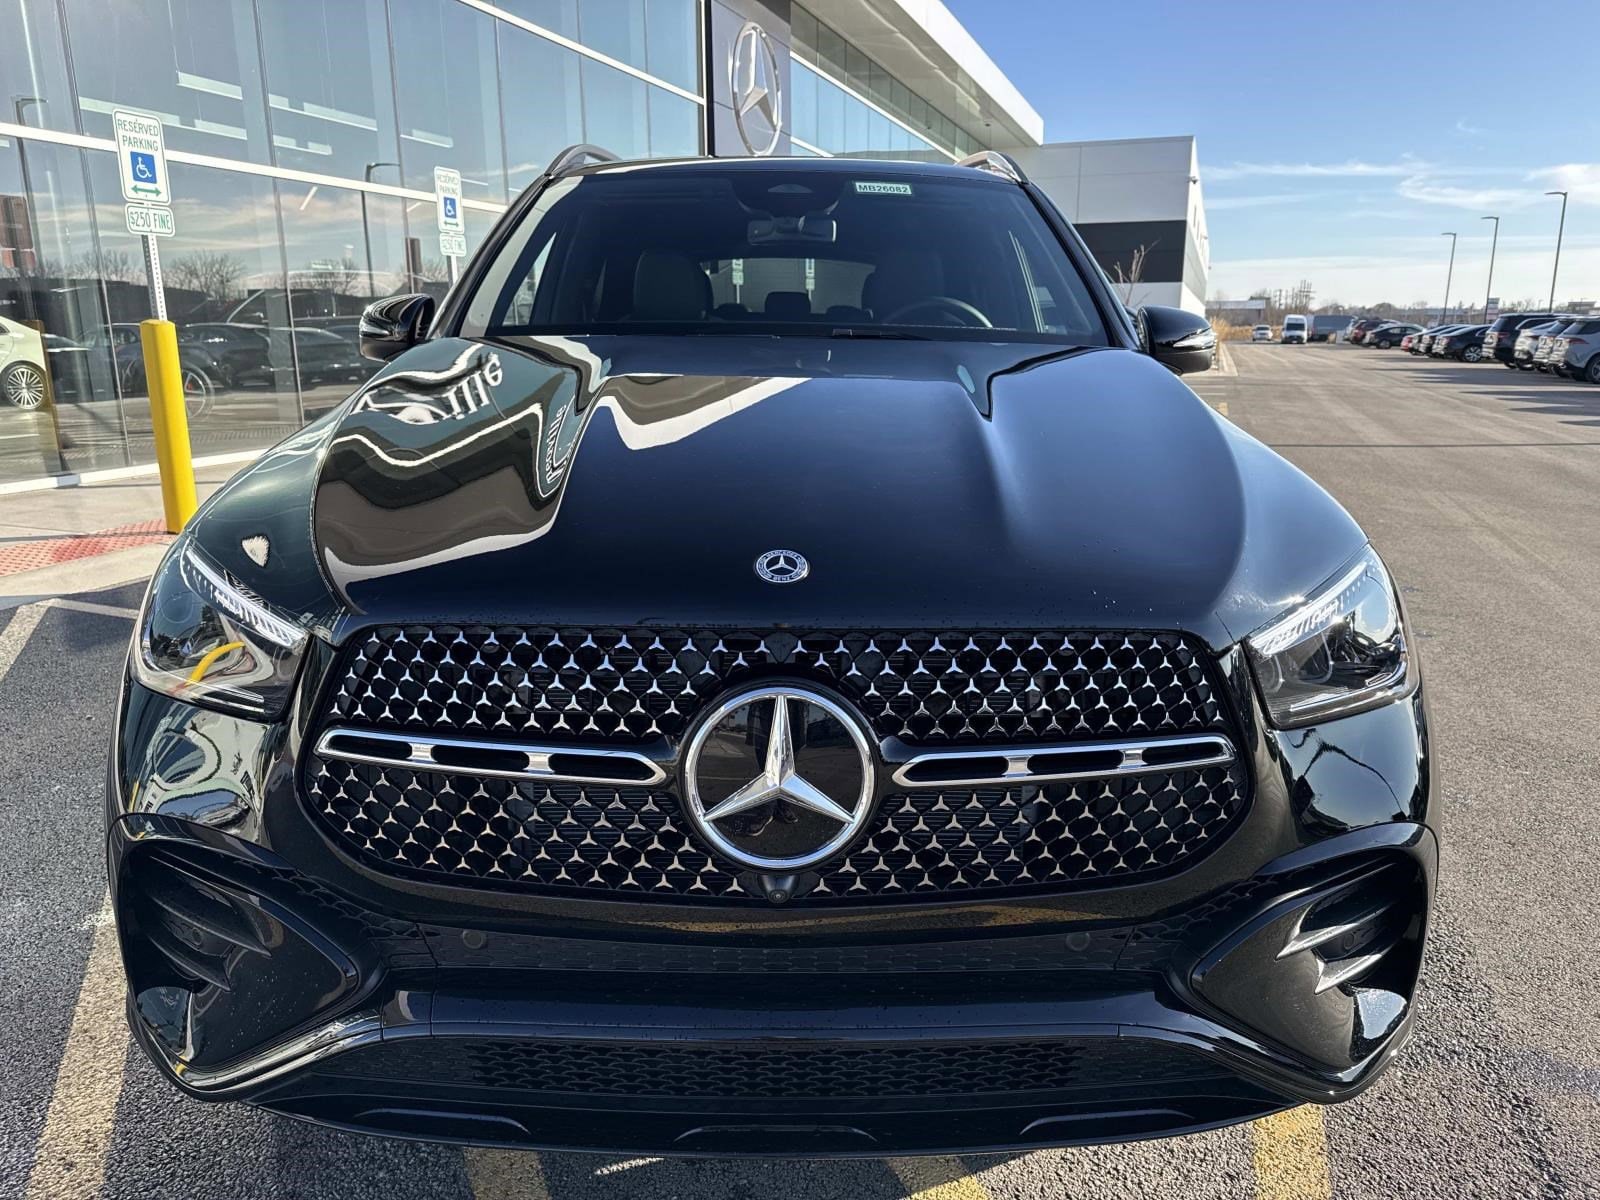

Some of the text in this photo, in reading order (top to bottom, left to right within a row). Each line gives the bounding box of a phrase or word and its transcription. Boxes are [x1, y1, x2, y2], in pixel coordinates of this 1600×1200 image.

[117, 119, 159, 137] RESERVED
[122, 135, 159, 152] PARKING
[130, 211, 171, 231] $250 FINE
